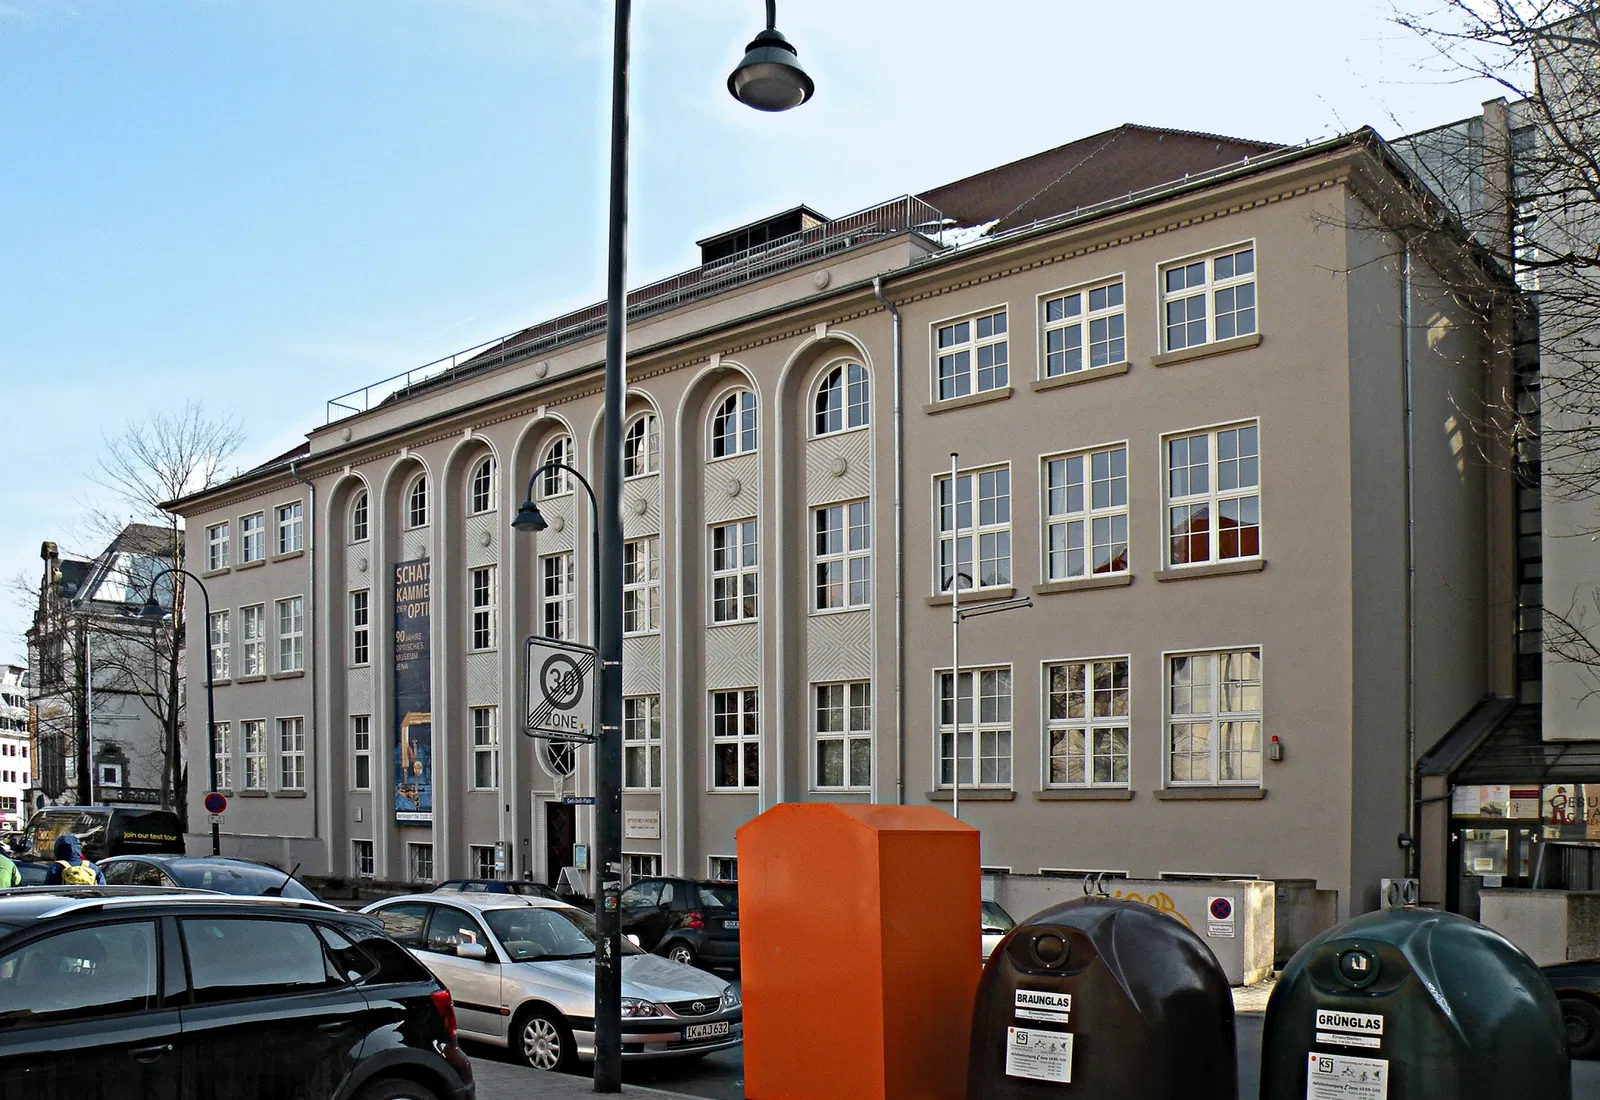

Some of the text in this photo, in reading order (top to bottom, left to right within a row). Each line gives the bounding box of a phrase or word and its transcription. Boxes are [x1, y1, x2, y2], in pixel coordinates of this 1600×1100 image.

[396, 562, 431, 585] SCHAT
[396, 583, 431, 602] KAMME
[407, 601, 431, 618] OPTI
[396, 630, 405, 643] 90
[545, 712, 578, 729] ZONE
[123, 831, 136, 839] join
[1017, 993, 1069, 1008] BRAUNGLAS
[1318, 1013, 1380, 1030] GRÜNGLAS
